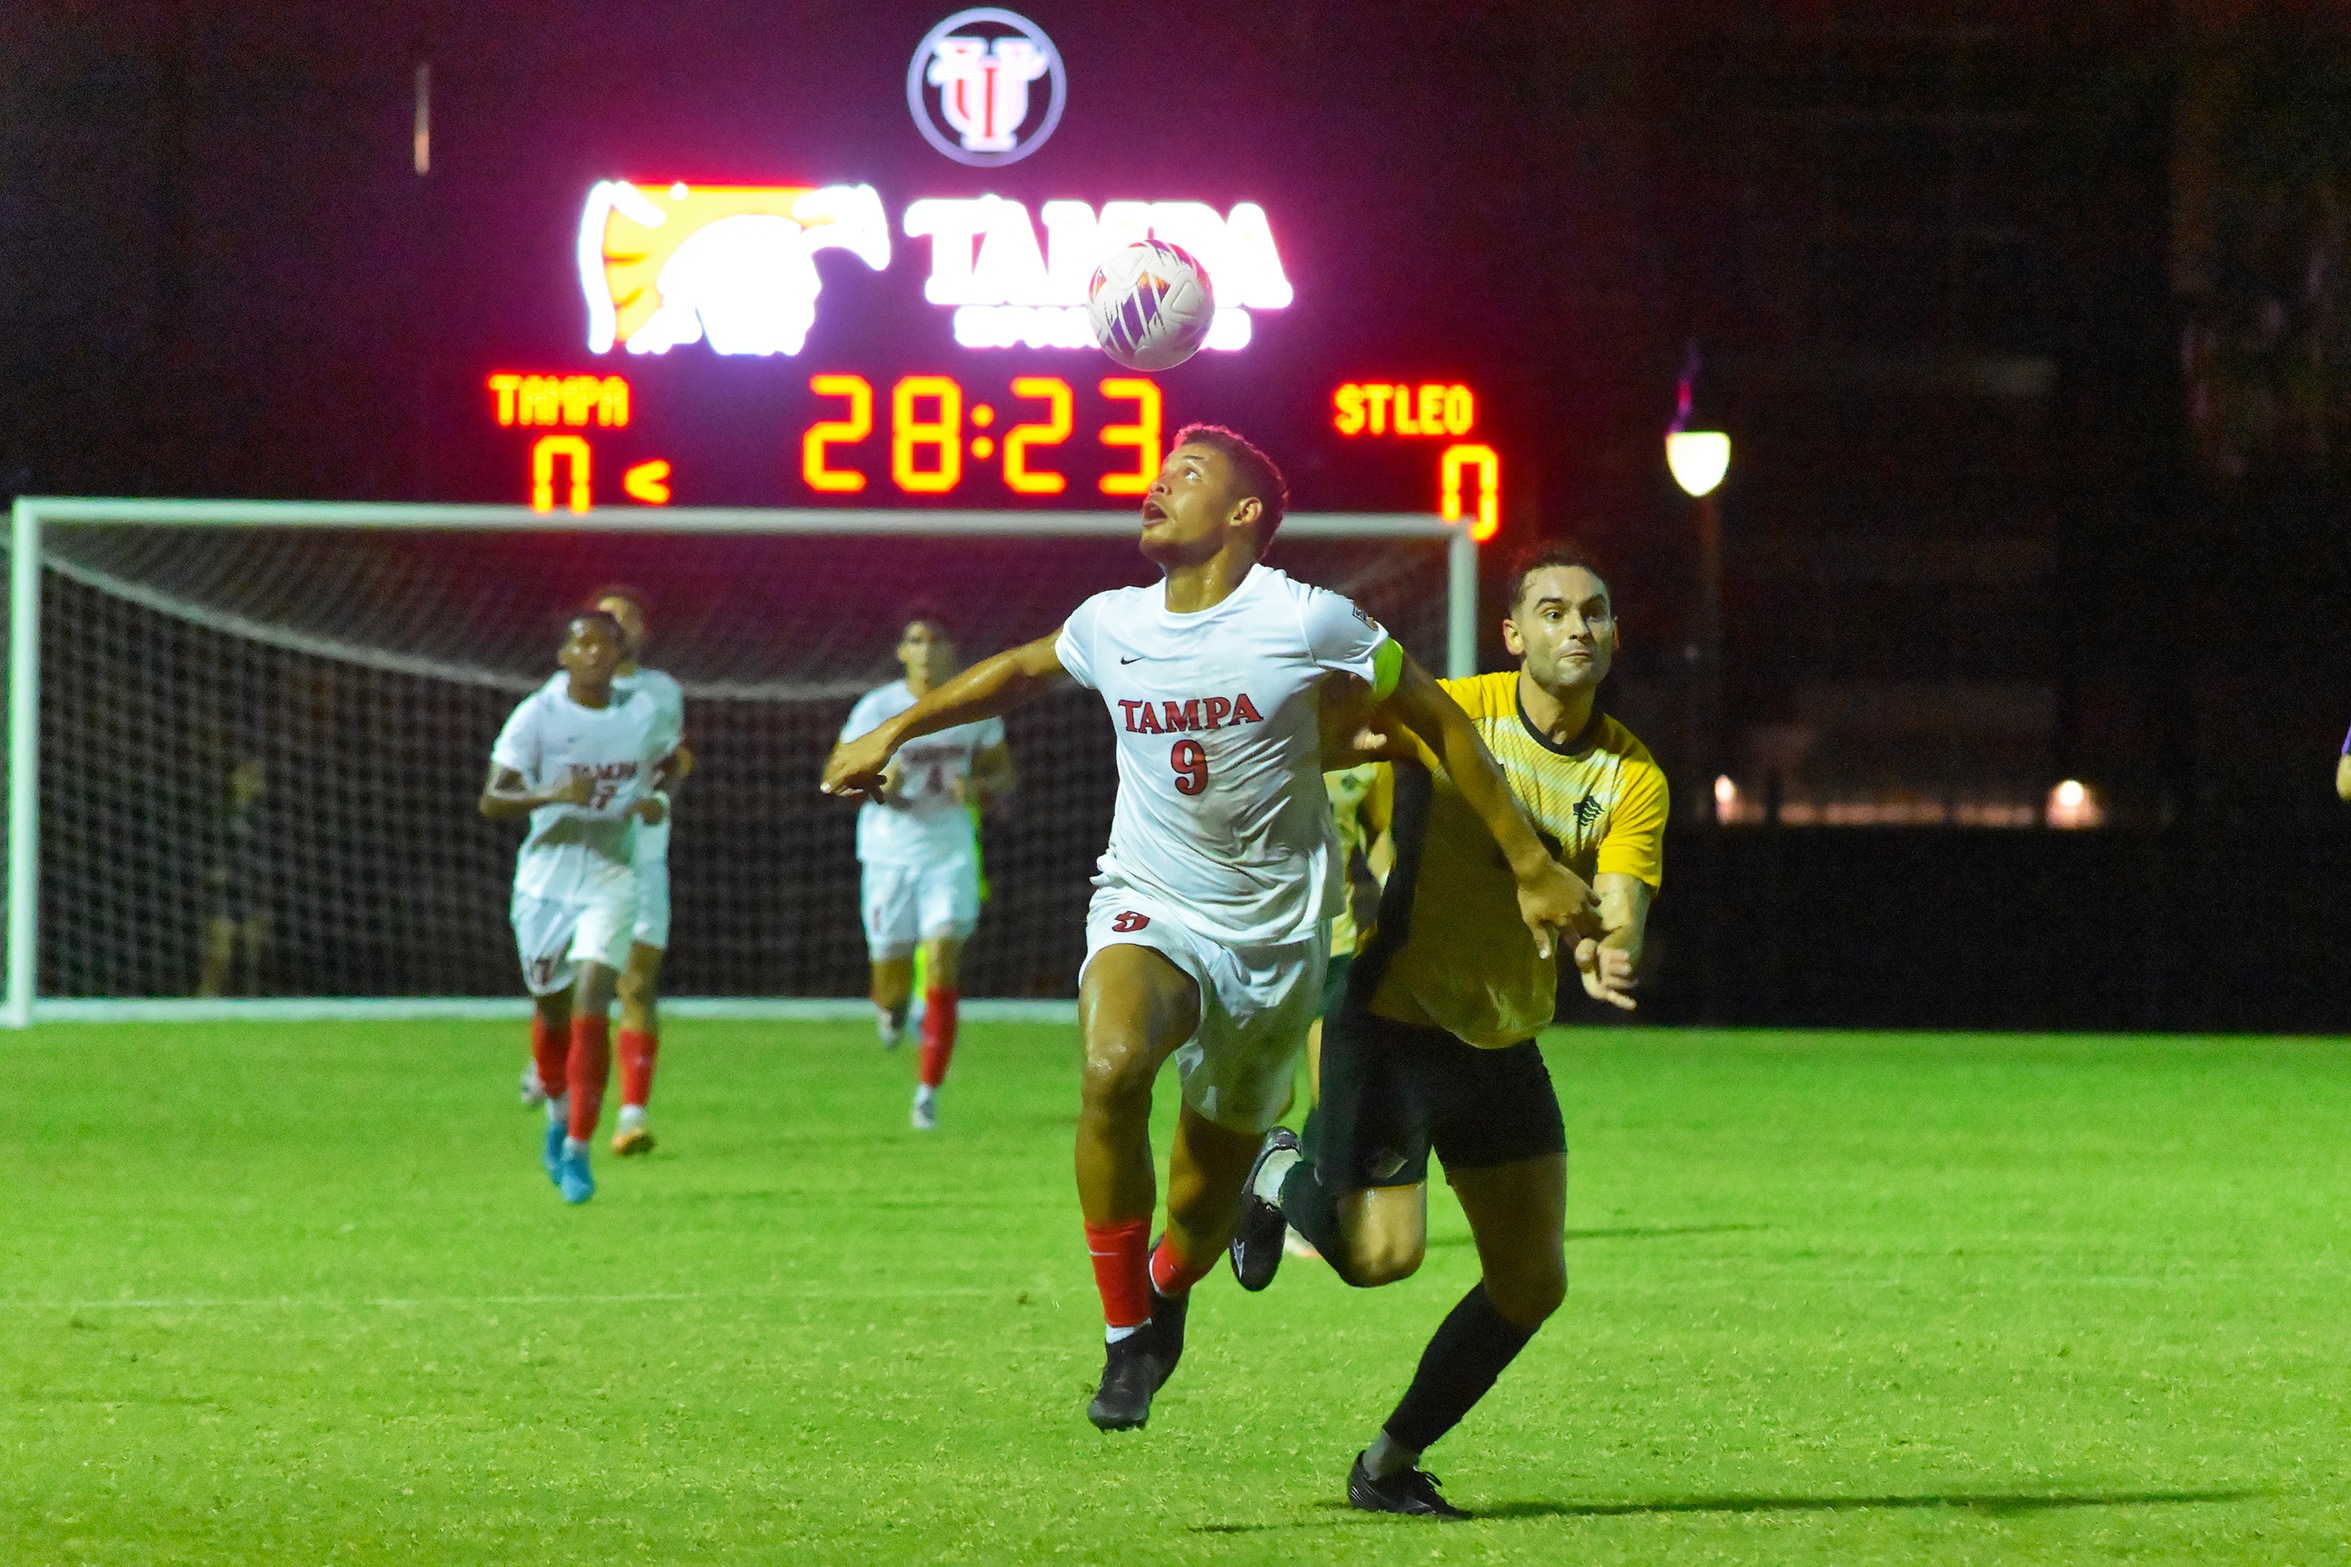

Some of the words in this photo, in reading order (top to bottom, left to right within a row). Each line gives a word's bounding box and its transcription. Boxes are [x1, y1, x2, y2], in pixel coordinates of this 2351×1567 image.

[488, 372, 629, 427] TAMPA
[802, 373, 1162, 495] 28:23
[1441, 443, 1499, 542] 0
[1117, 692, 1265, 735] TAMPA
[1170, 738, 1209, 796] 9
